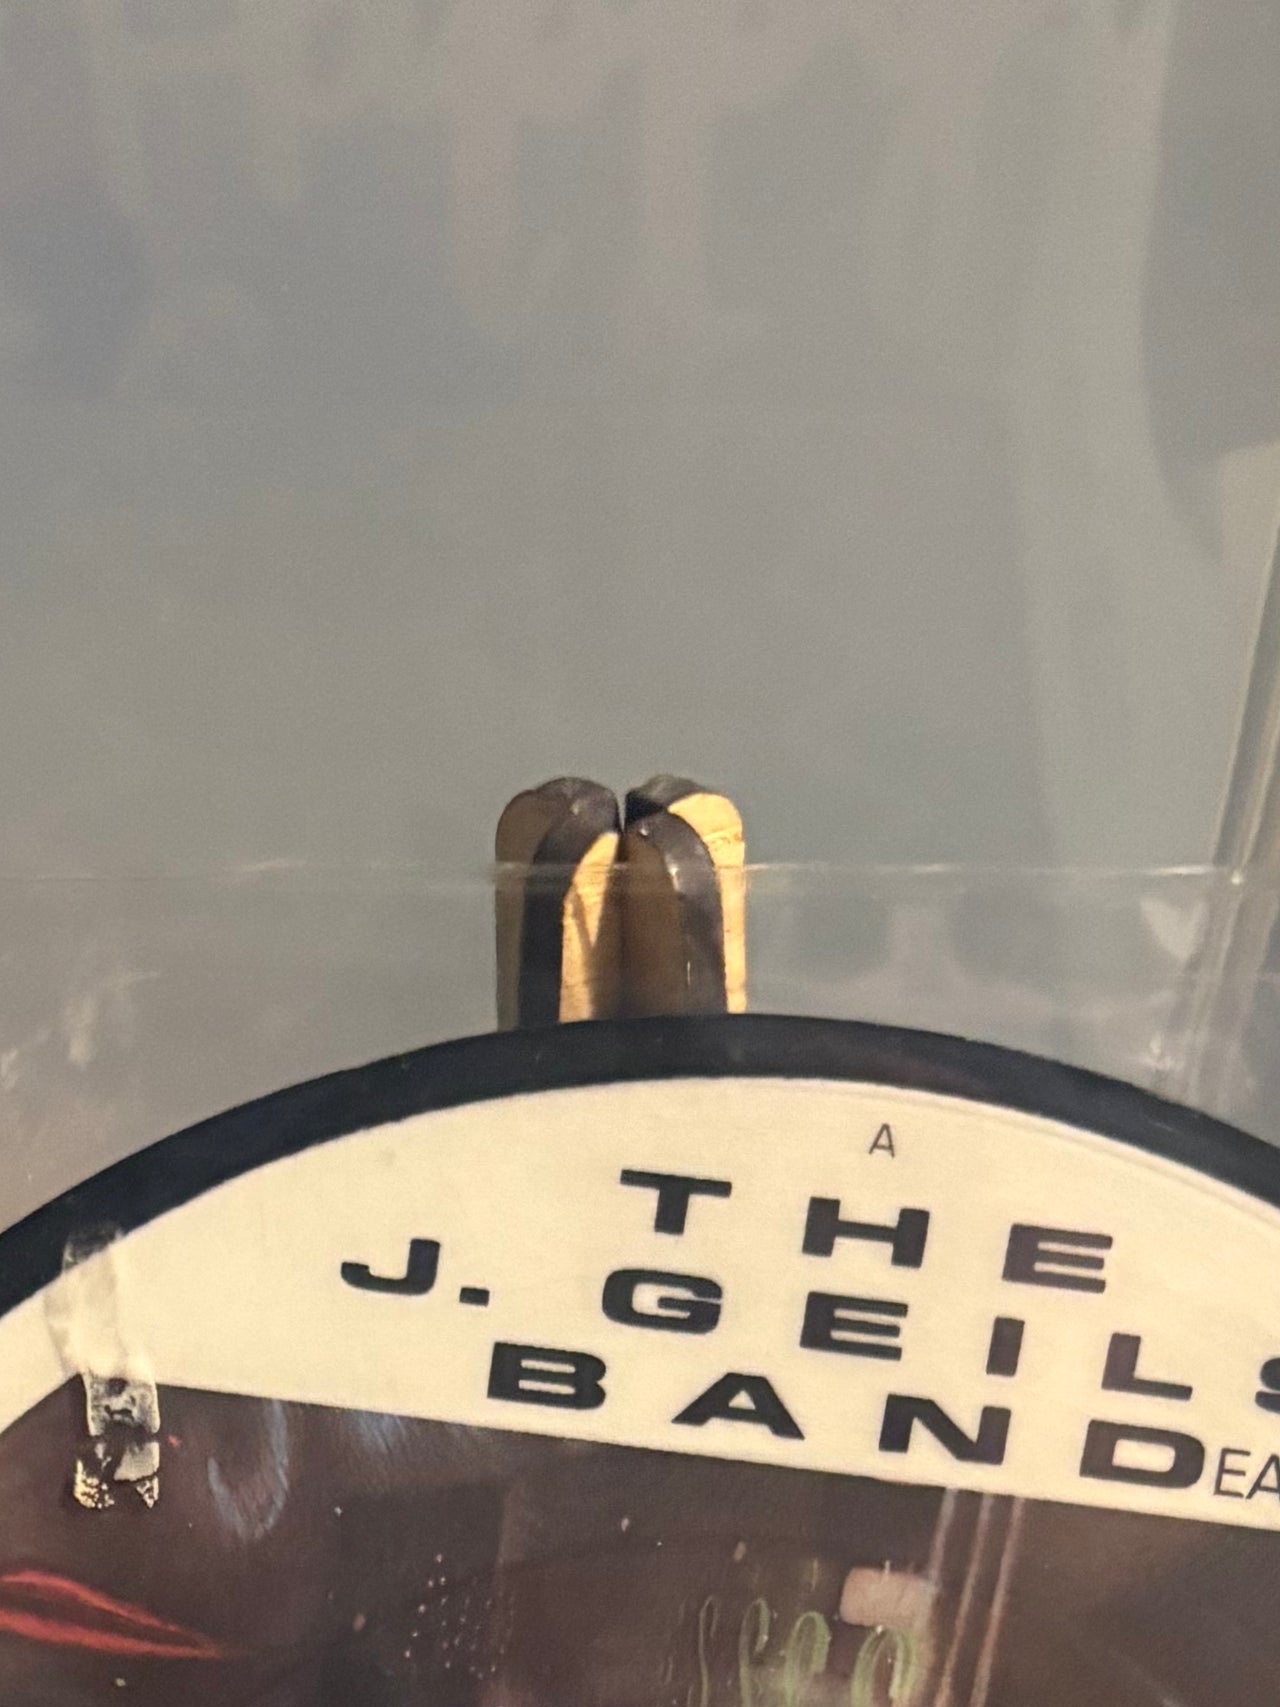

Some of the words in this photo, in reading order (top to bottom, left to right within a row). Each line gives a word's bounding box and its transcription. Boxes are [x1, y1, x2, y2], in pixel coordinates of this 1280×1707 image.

[869, 1122, 896, 1157] A
[339, 1237, 491, 1307] J.
[619, 1168, 1114, 1294] THE
[486, 1340, 1207, 1489] BAND
